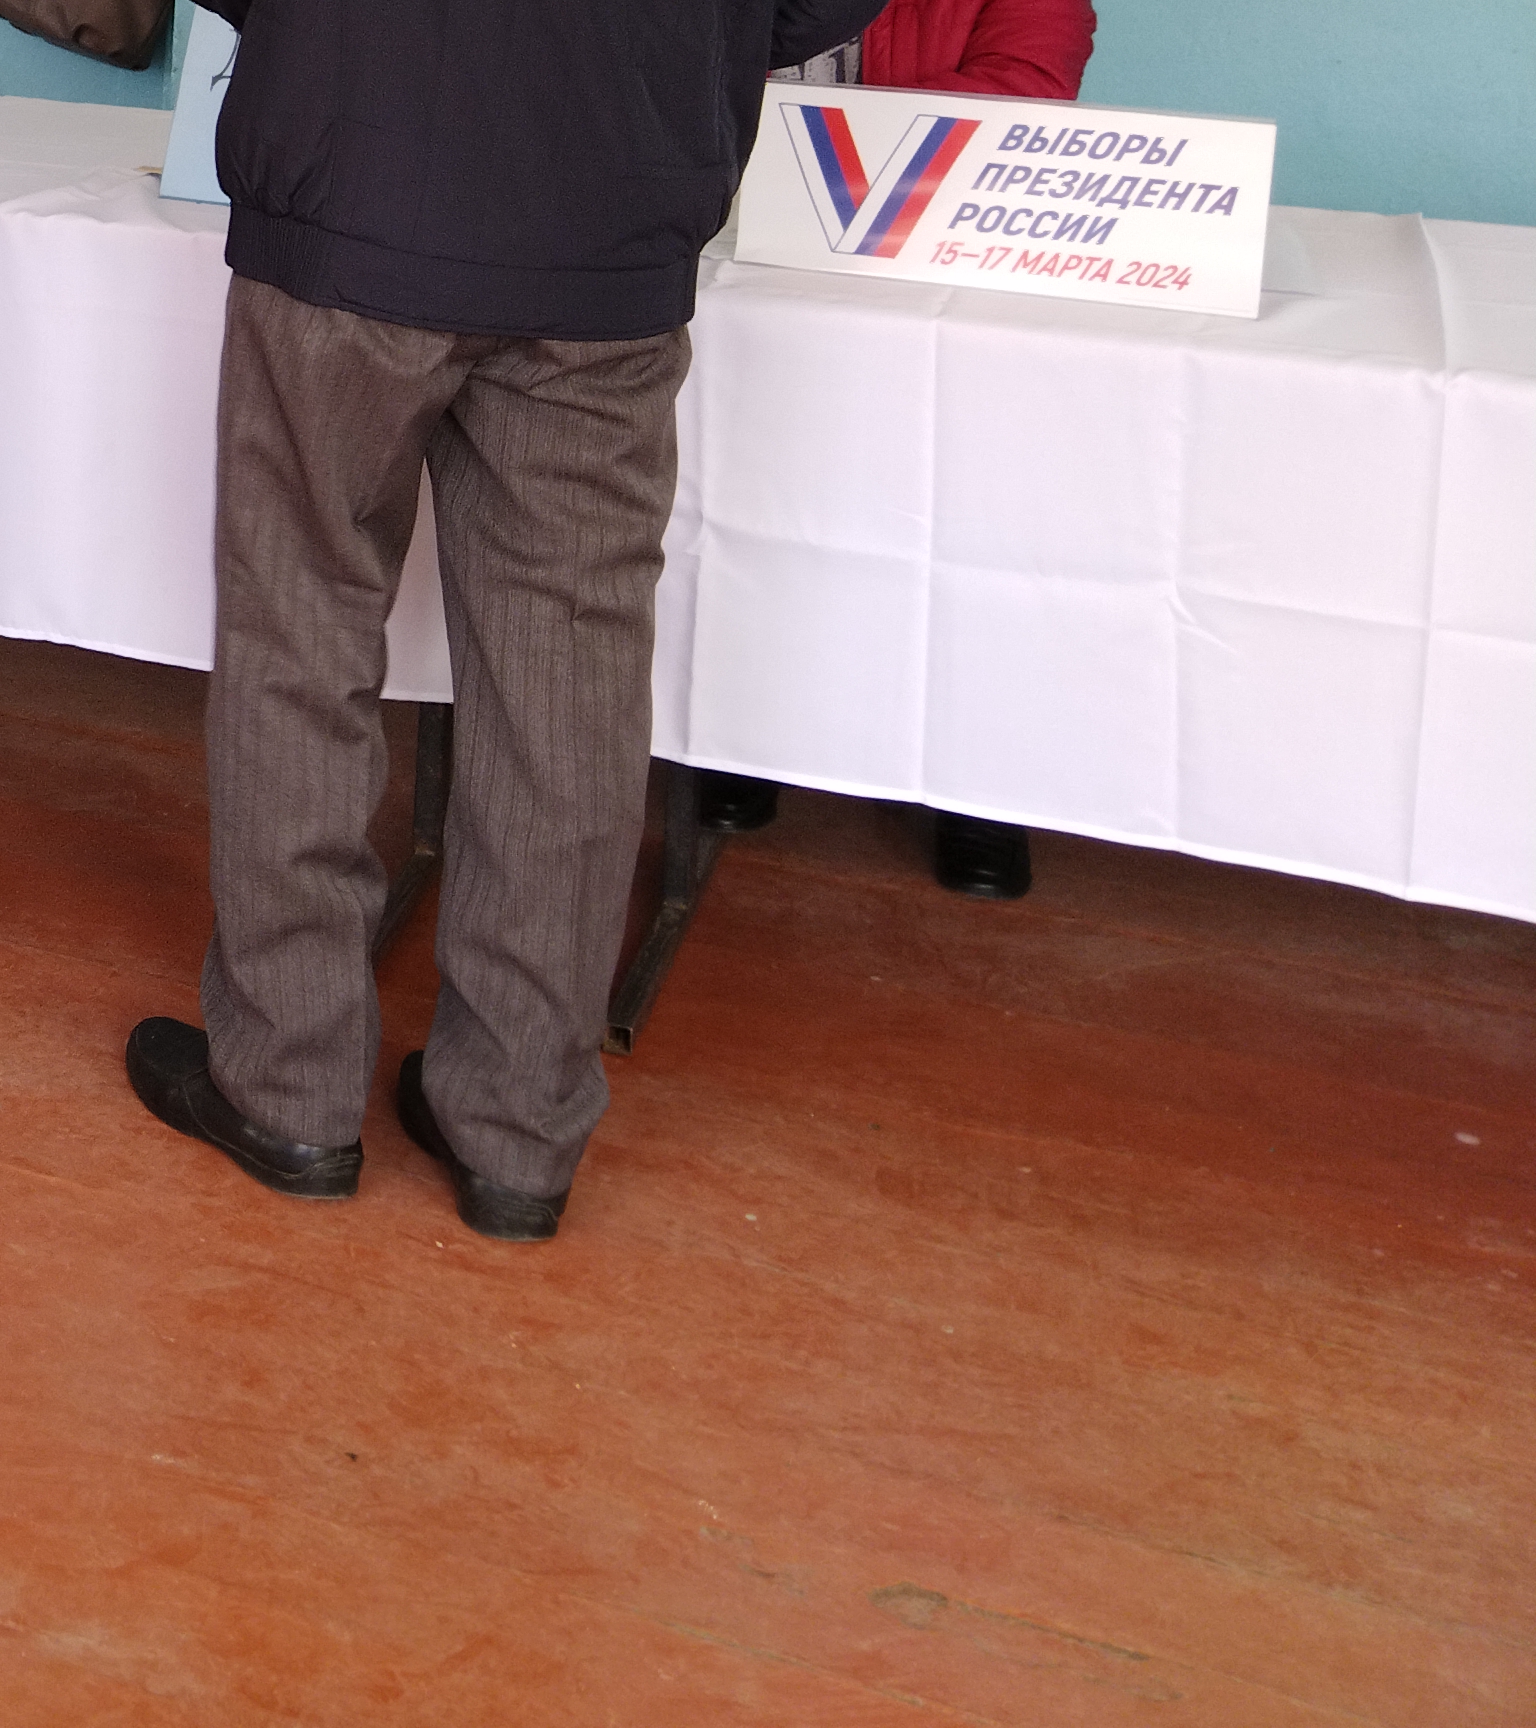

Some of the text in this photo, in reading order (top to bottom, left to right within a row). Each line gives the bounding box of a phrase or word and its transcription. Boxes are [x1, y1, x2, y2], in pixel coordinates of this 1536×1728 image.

[997, 124, 1188, 168] ВЫБОРЫ
[972, 163, 1241, 216] ПРЕЗИДЕНТА
[947, 202, 1119, 245] РОССИИ
[1010, 250, 1115, 282] МАРТА
[1116, 262, 1192, 291] 2024
